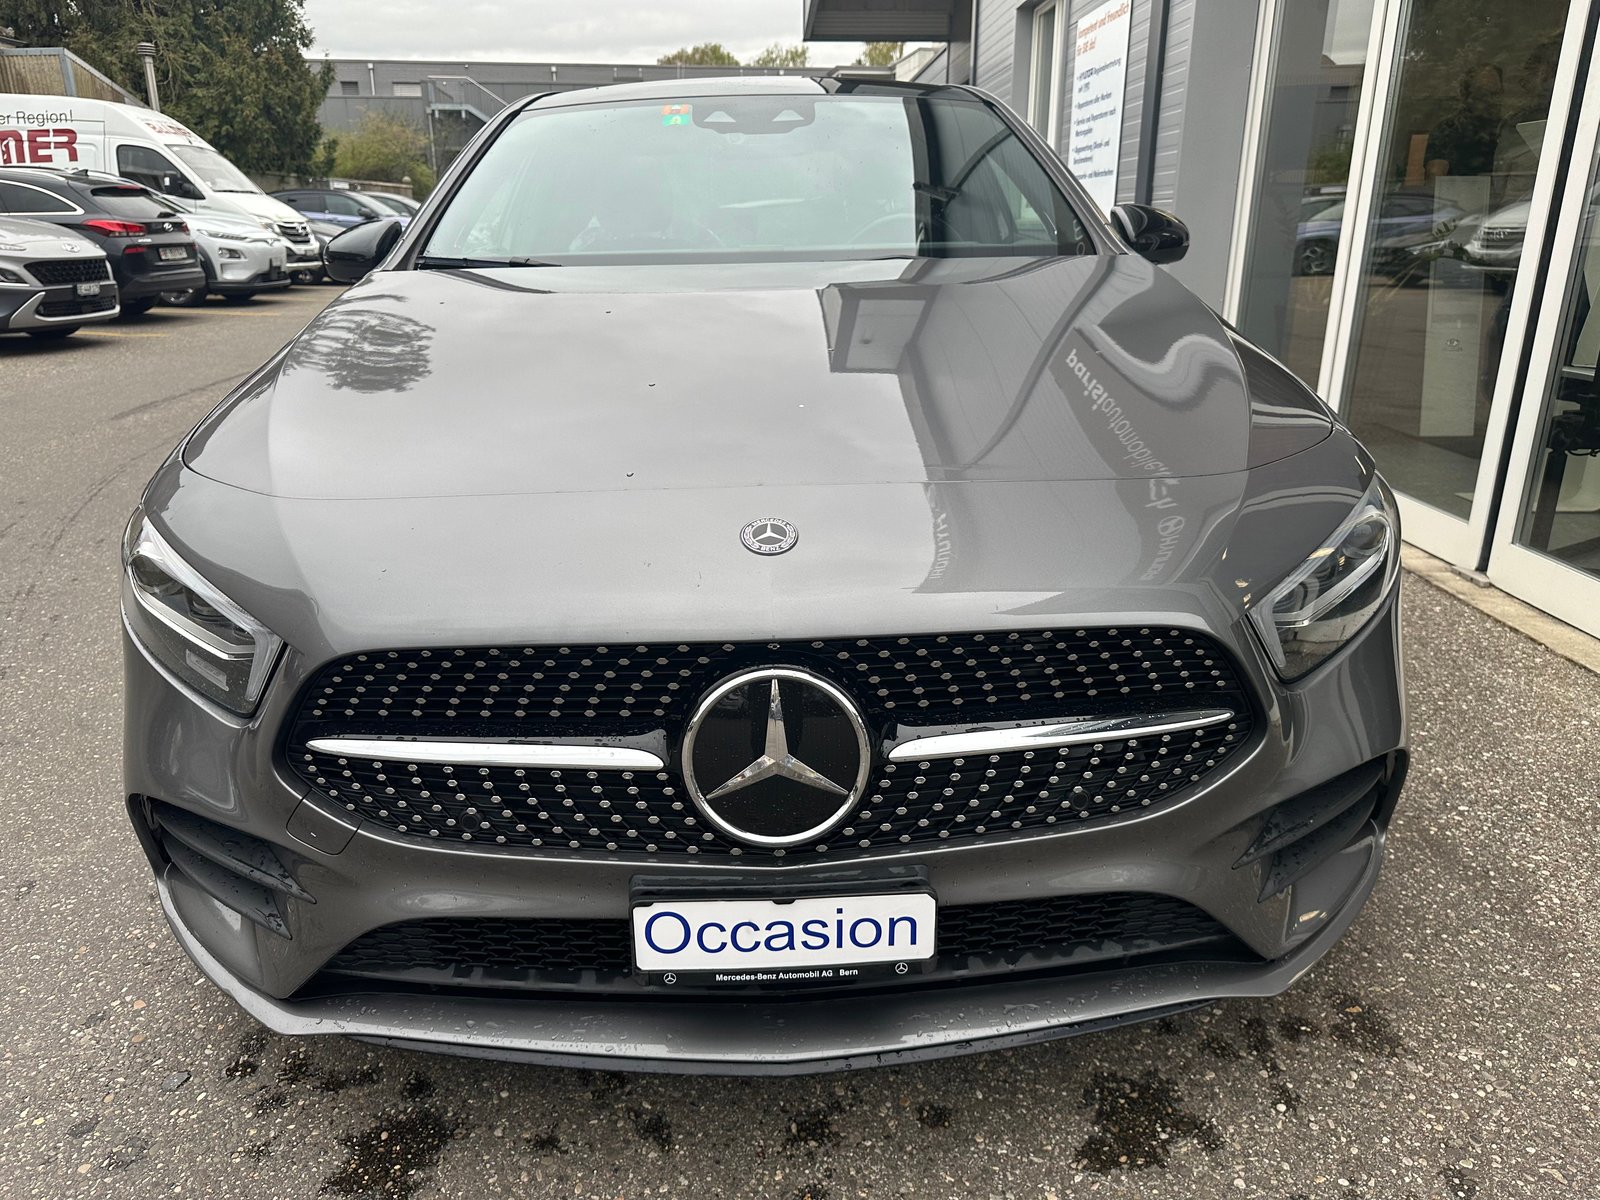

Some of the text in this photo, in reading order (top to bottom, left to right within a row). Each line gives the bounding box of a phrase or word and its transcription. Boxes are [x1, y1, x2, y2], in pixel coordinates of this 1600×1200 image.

[16, 109, 74, 127] Region!
[644, 907, 918, 954] Occasion
[715, 971, 777, 981] Mercedes-Benz
[778, 970, 820, 979] Automobil
[839, 968, 858, 976] Bern
